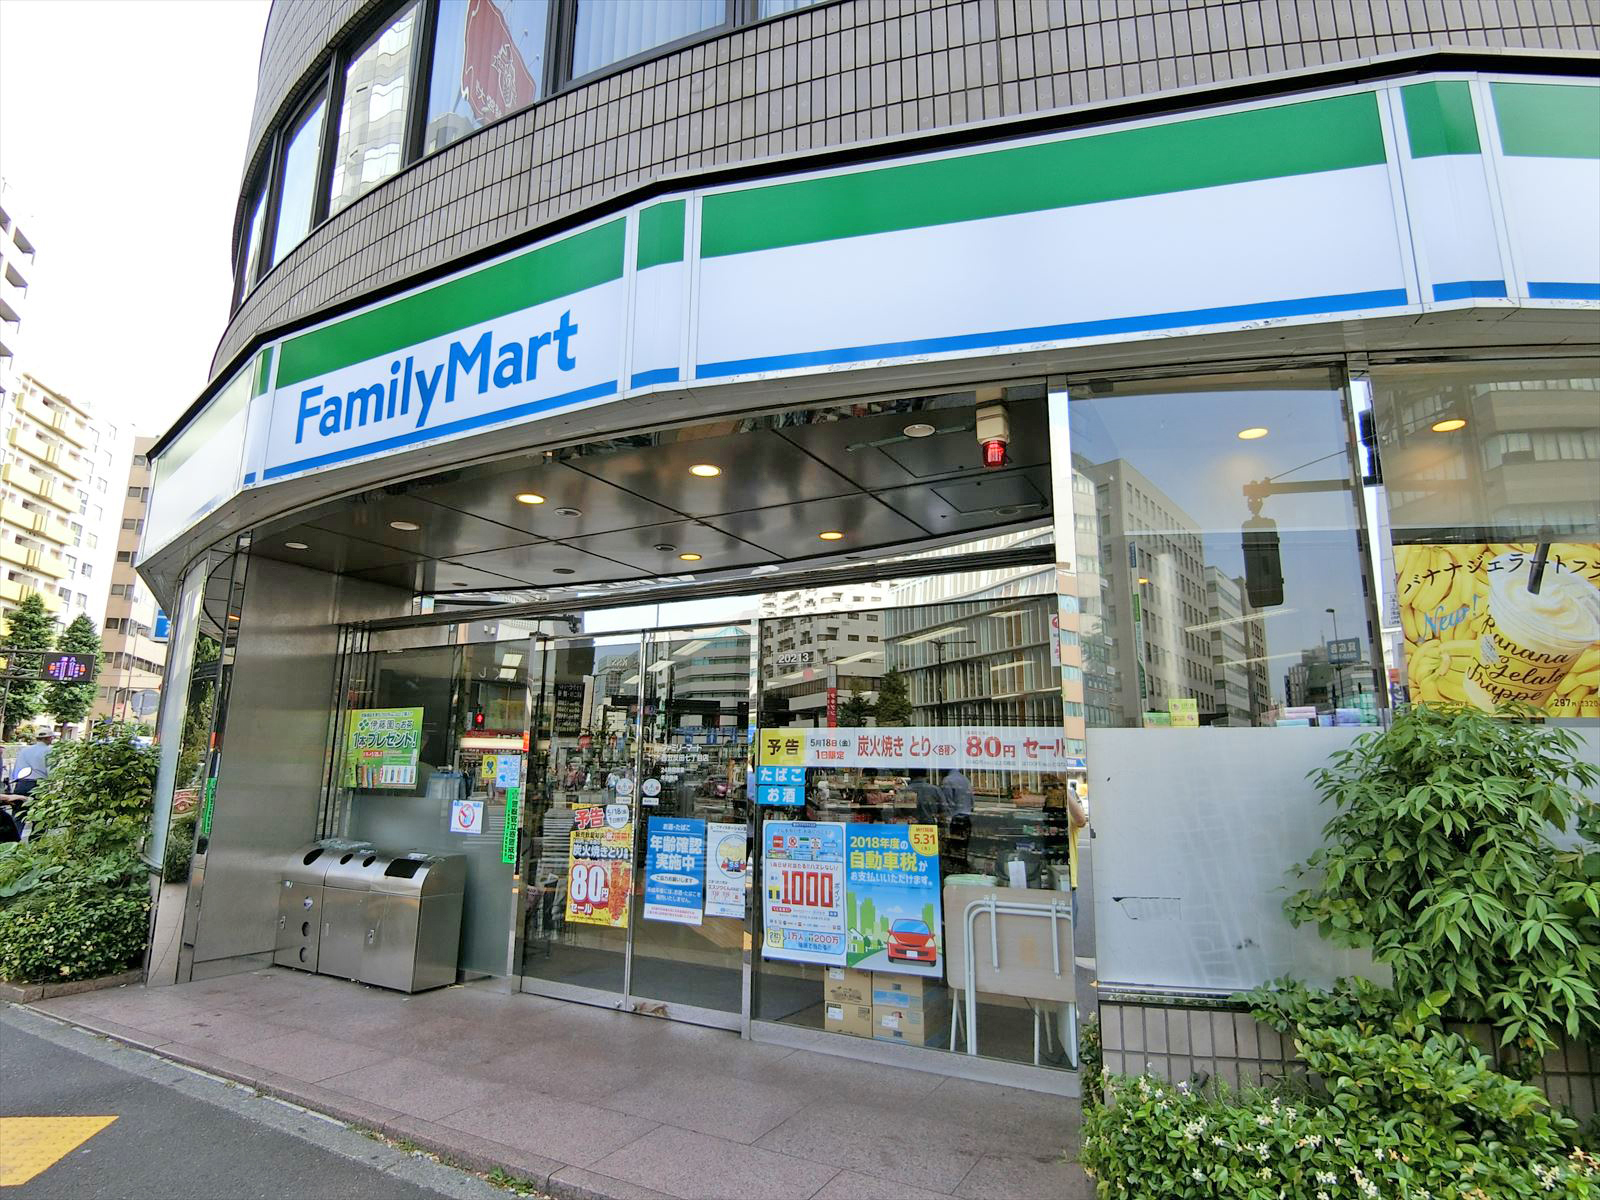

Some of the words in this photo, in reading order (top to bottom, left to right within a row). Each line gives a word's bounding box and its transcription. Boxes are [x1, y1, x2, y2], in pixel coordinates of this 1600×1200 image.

[295, 309, 578, 444] FamilyMart
[767, 738, 799, 756] 予告
[966, 735, 1016, 758] 80円
[816, 750, 845, 760] 1日限定
[761, 768, 802, 782] たばこ
[767, 787, 796, 803] お酒
[575, 807, 605, 829] 予告
[650, 834, 702, 854] 年齢確認
[850, 836, 908, 850] 2018年度の
[913, 833, 936, 845] 5.31
[655, 852, 695, 872] 実施中
[571, 864, 609, 902] 80円
[782, 870, 833, 908] 1000
[571, 903, 592, 914] セール
